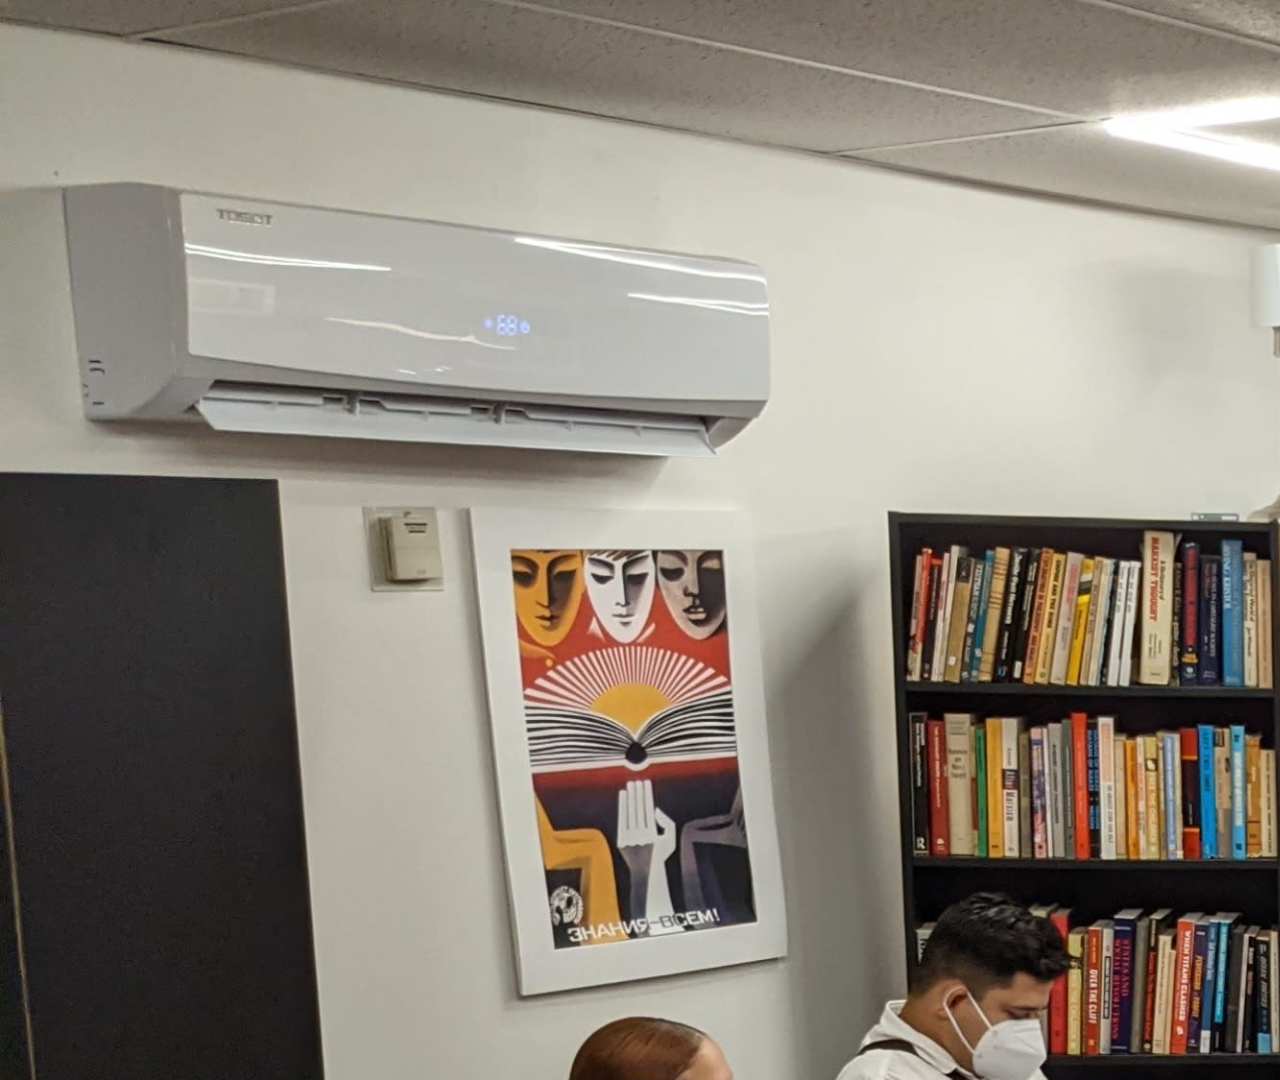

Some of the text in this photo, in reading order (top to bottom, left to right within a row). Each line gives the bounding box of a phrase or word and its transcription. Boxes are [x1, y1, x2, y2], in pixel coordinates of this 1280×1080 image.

[1149, 537, 1159, 622] MARXIST THOUGHT
[1088, 969, 1098, 1024] OVER THE CLIFF
[1121, 975, 1130, 997] AND
[1178, 930, 1192, 1021] WHEN TITANS CLASHED
